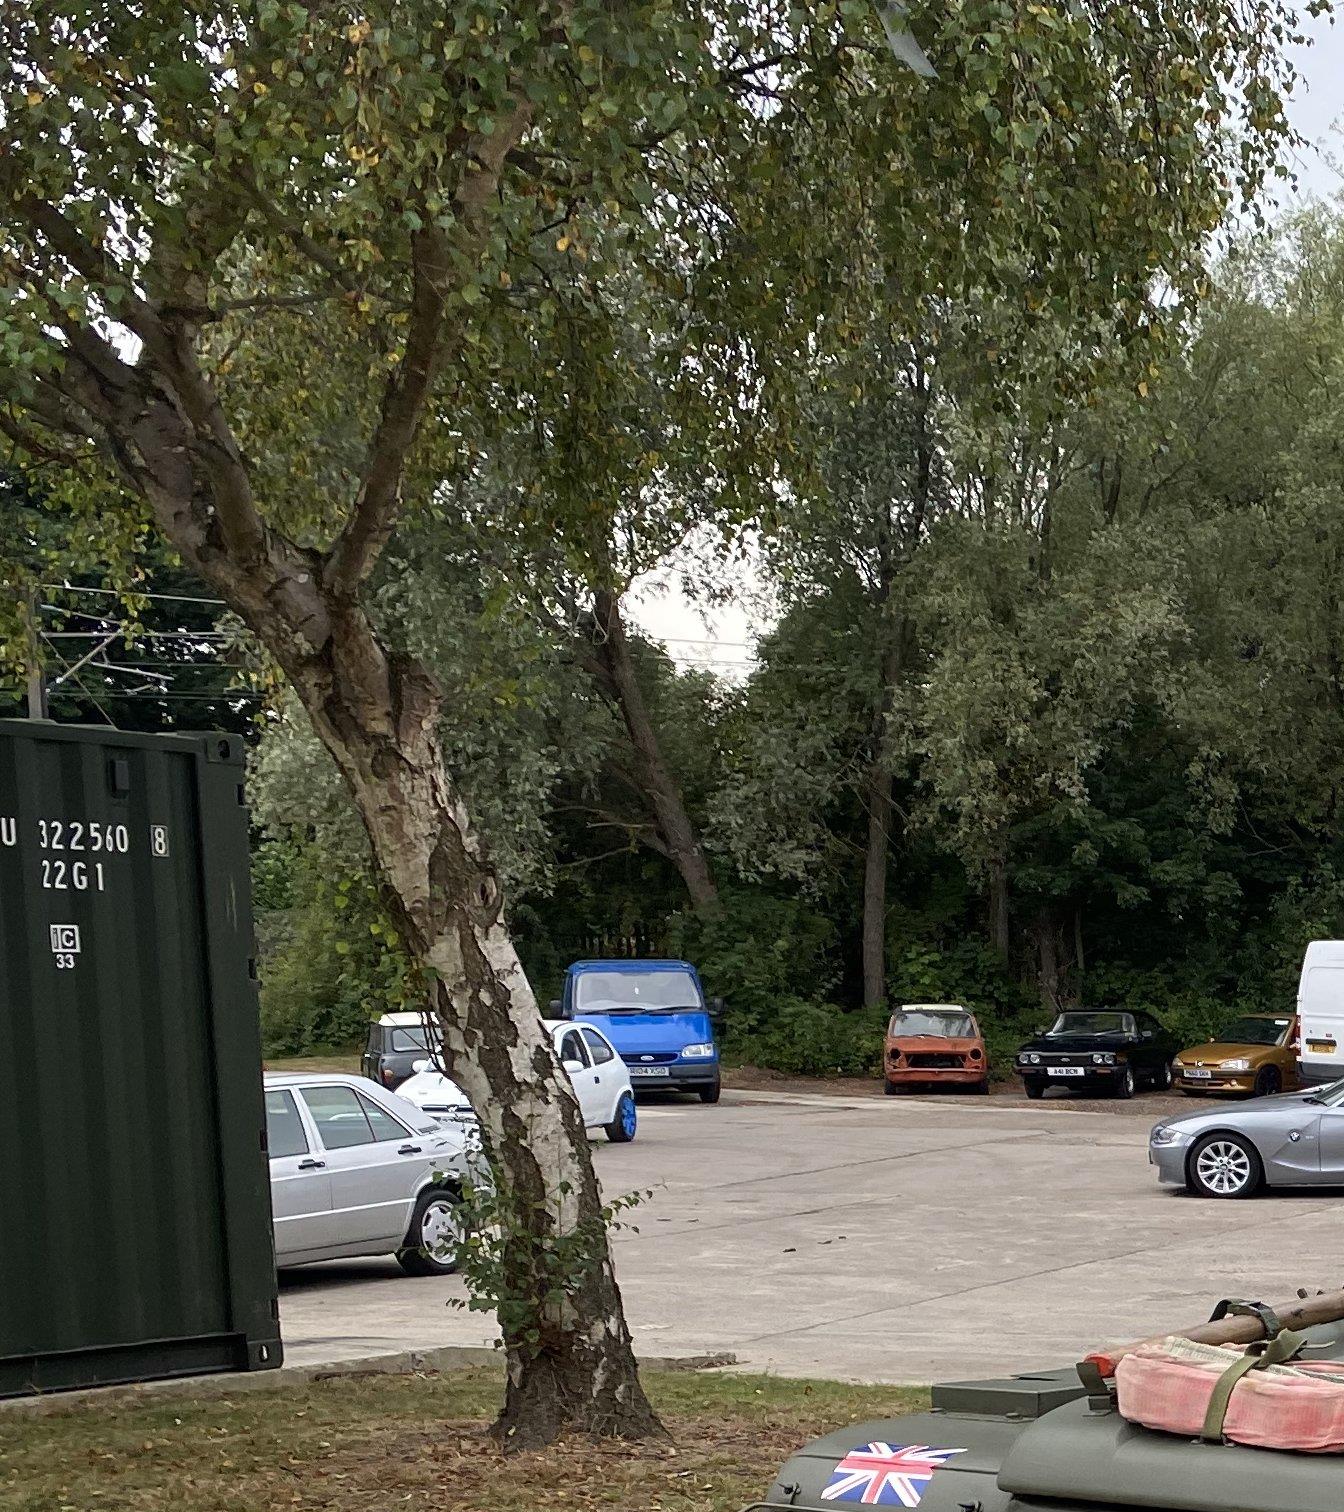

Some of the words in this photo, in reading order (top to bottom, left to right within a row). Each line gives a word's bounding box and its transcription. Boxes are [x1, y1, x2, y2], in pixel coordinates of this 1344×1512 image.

[154, 828, 166, 854] 8
[41, 860, 105, 891] 22G1
[55, 953, 75, 969] 33
